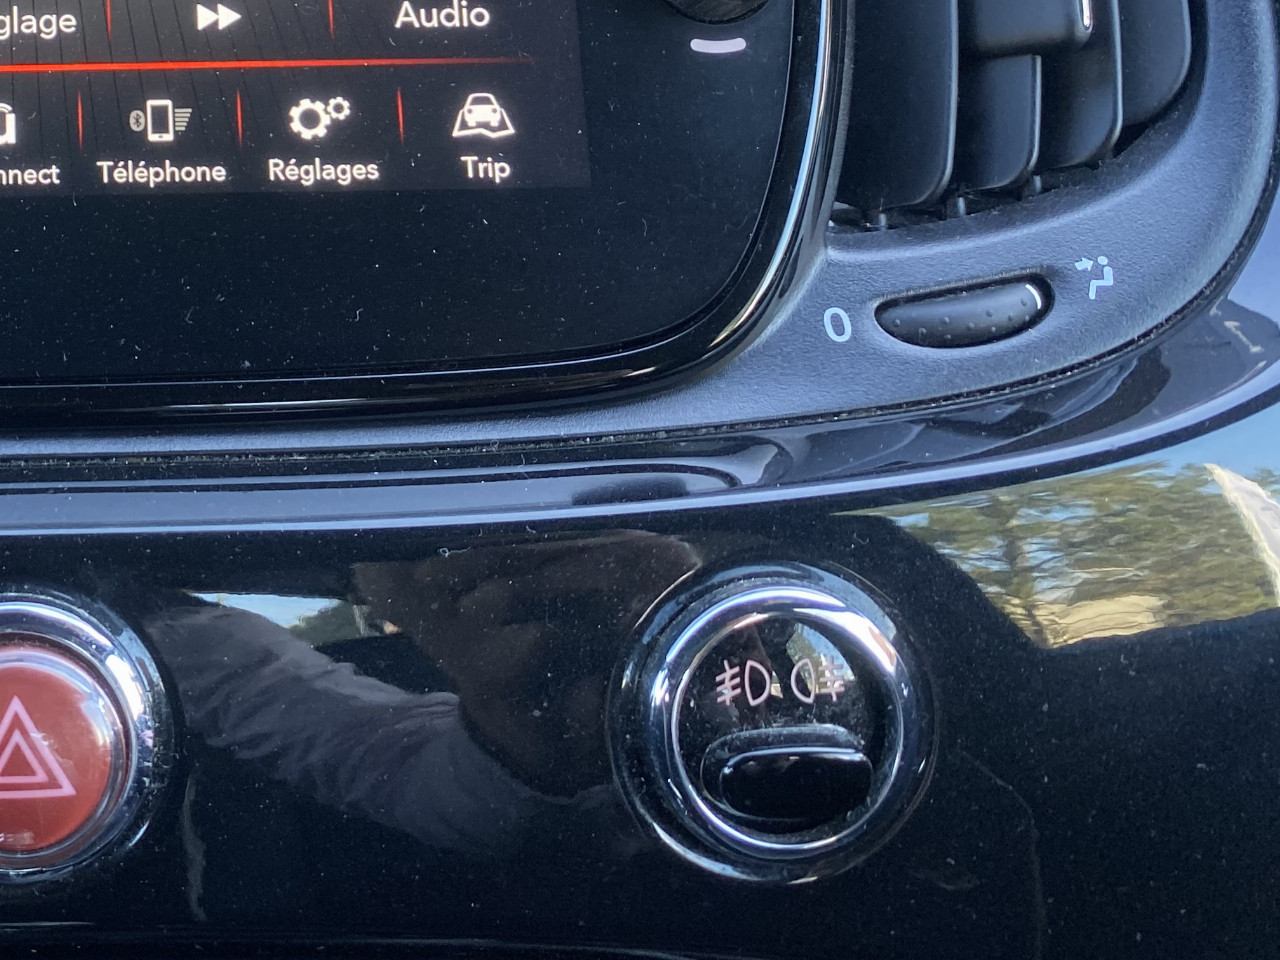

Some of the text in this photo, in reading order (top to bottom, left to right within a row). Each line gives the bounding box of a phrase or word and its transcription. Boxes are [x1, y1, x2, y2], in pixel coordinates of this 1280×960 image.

[394, 0, 491, 29] Audio
[96, 159, 227, 187] Téléphone
[268, 158, 380, 186] Réglages
[460, 156, 511, 183] Trip
